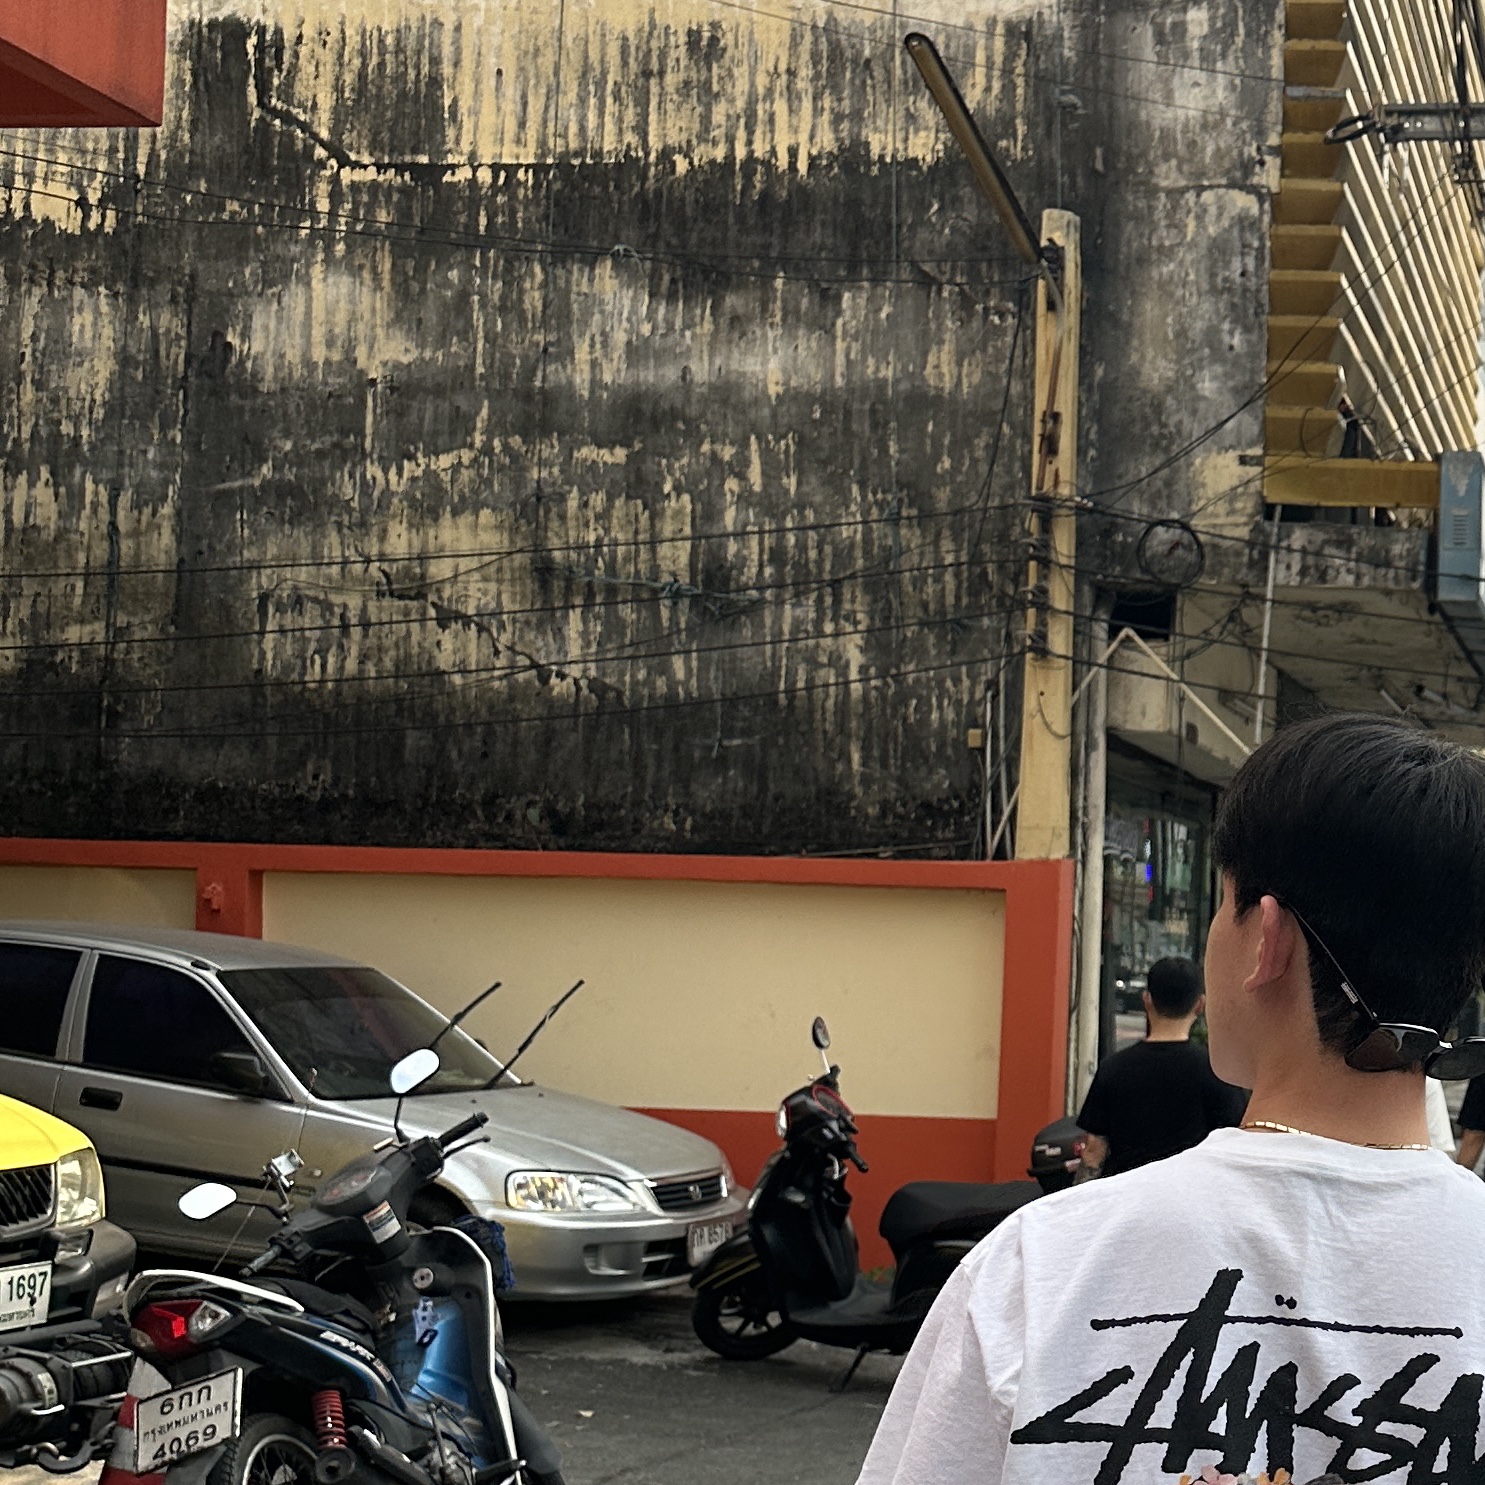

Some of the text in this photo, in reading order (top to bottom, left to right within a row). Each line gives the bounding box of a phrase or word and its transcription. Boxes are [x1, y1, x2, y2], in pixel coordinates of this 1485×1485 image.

[8, 1270, 48, 1302] 1697
[160, 1384, 212, 1416] 6กก
[153, 1424, 218, 1461] 4069
